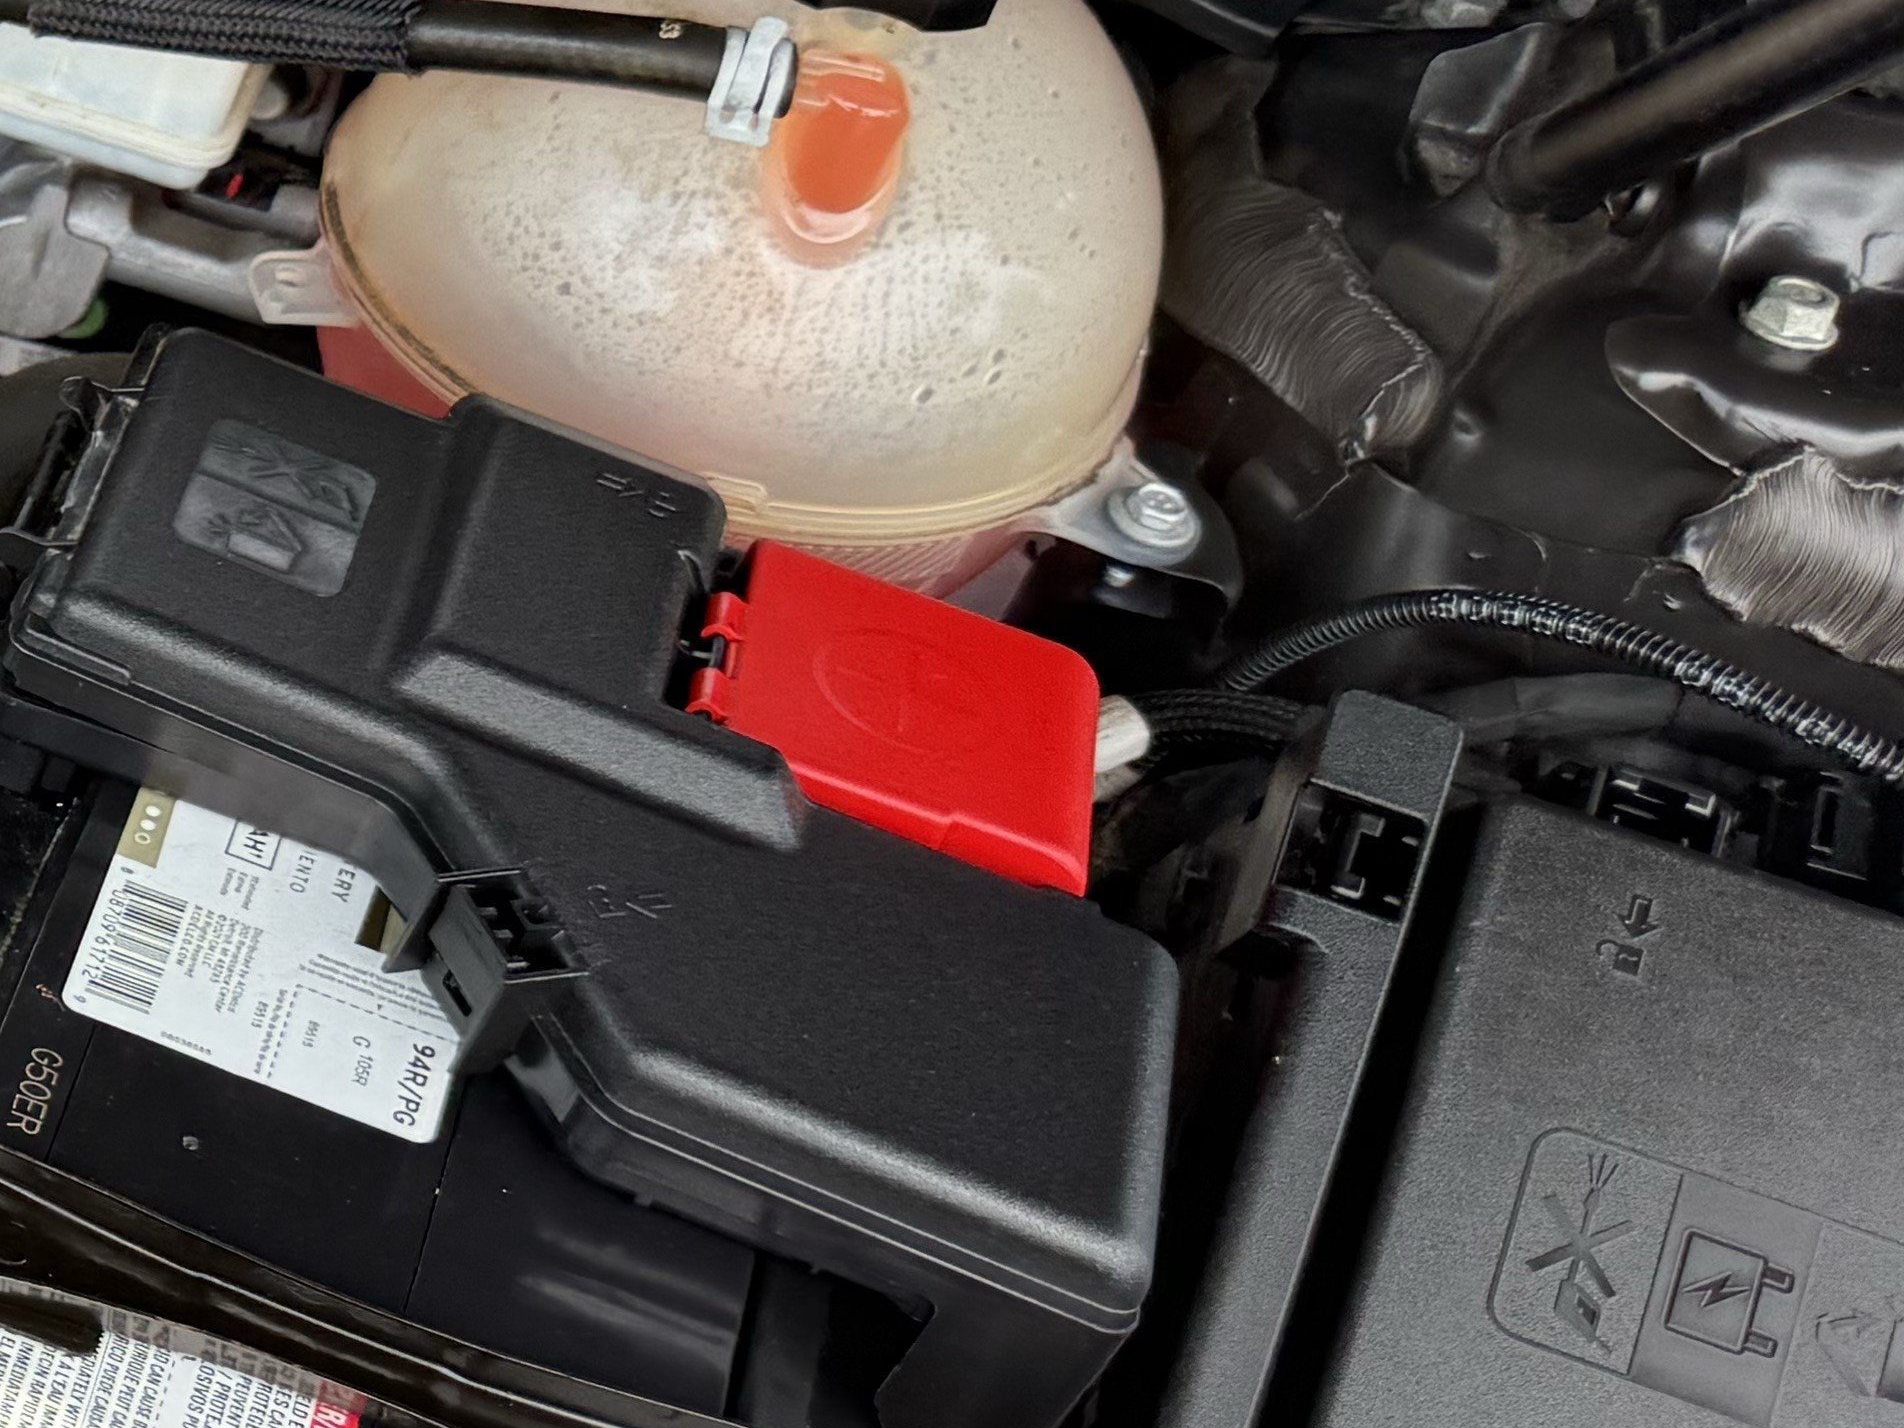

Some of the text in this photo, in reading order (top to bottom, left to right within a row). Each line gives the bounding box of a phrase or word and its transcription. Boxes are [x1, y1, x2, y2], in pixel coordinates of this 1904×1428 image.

[288, 848, 316, 894] IENTO
[330, 867, 356, 902] ERY
[350, 1034, 374, 1087] G 105R
[6, 1047, 63, 1135] G50ER
[391, 1042, 436, 1127] 94R/PG
[96, 1361, 120, 1396] PUEDE
[145, 1362, 165, 1387] CAN
[114, 1382, 136, 1412] PEUT
[134, 1384, 158, 1420] CAUSE
